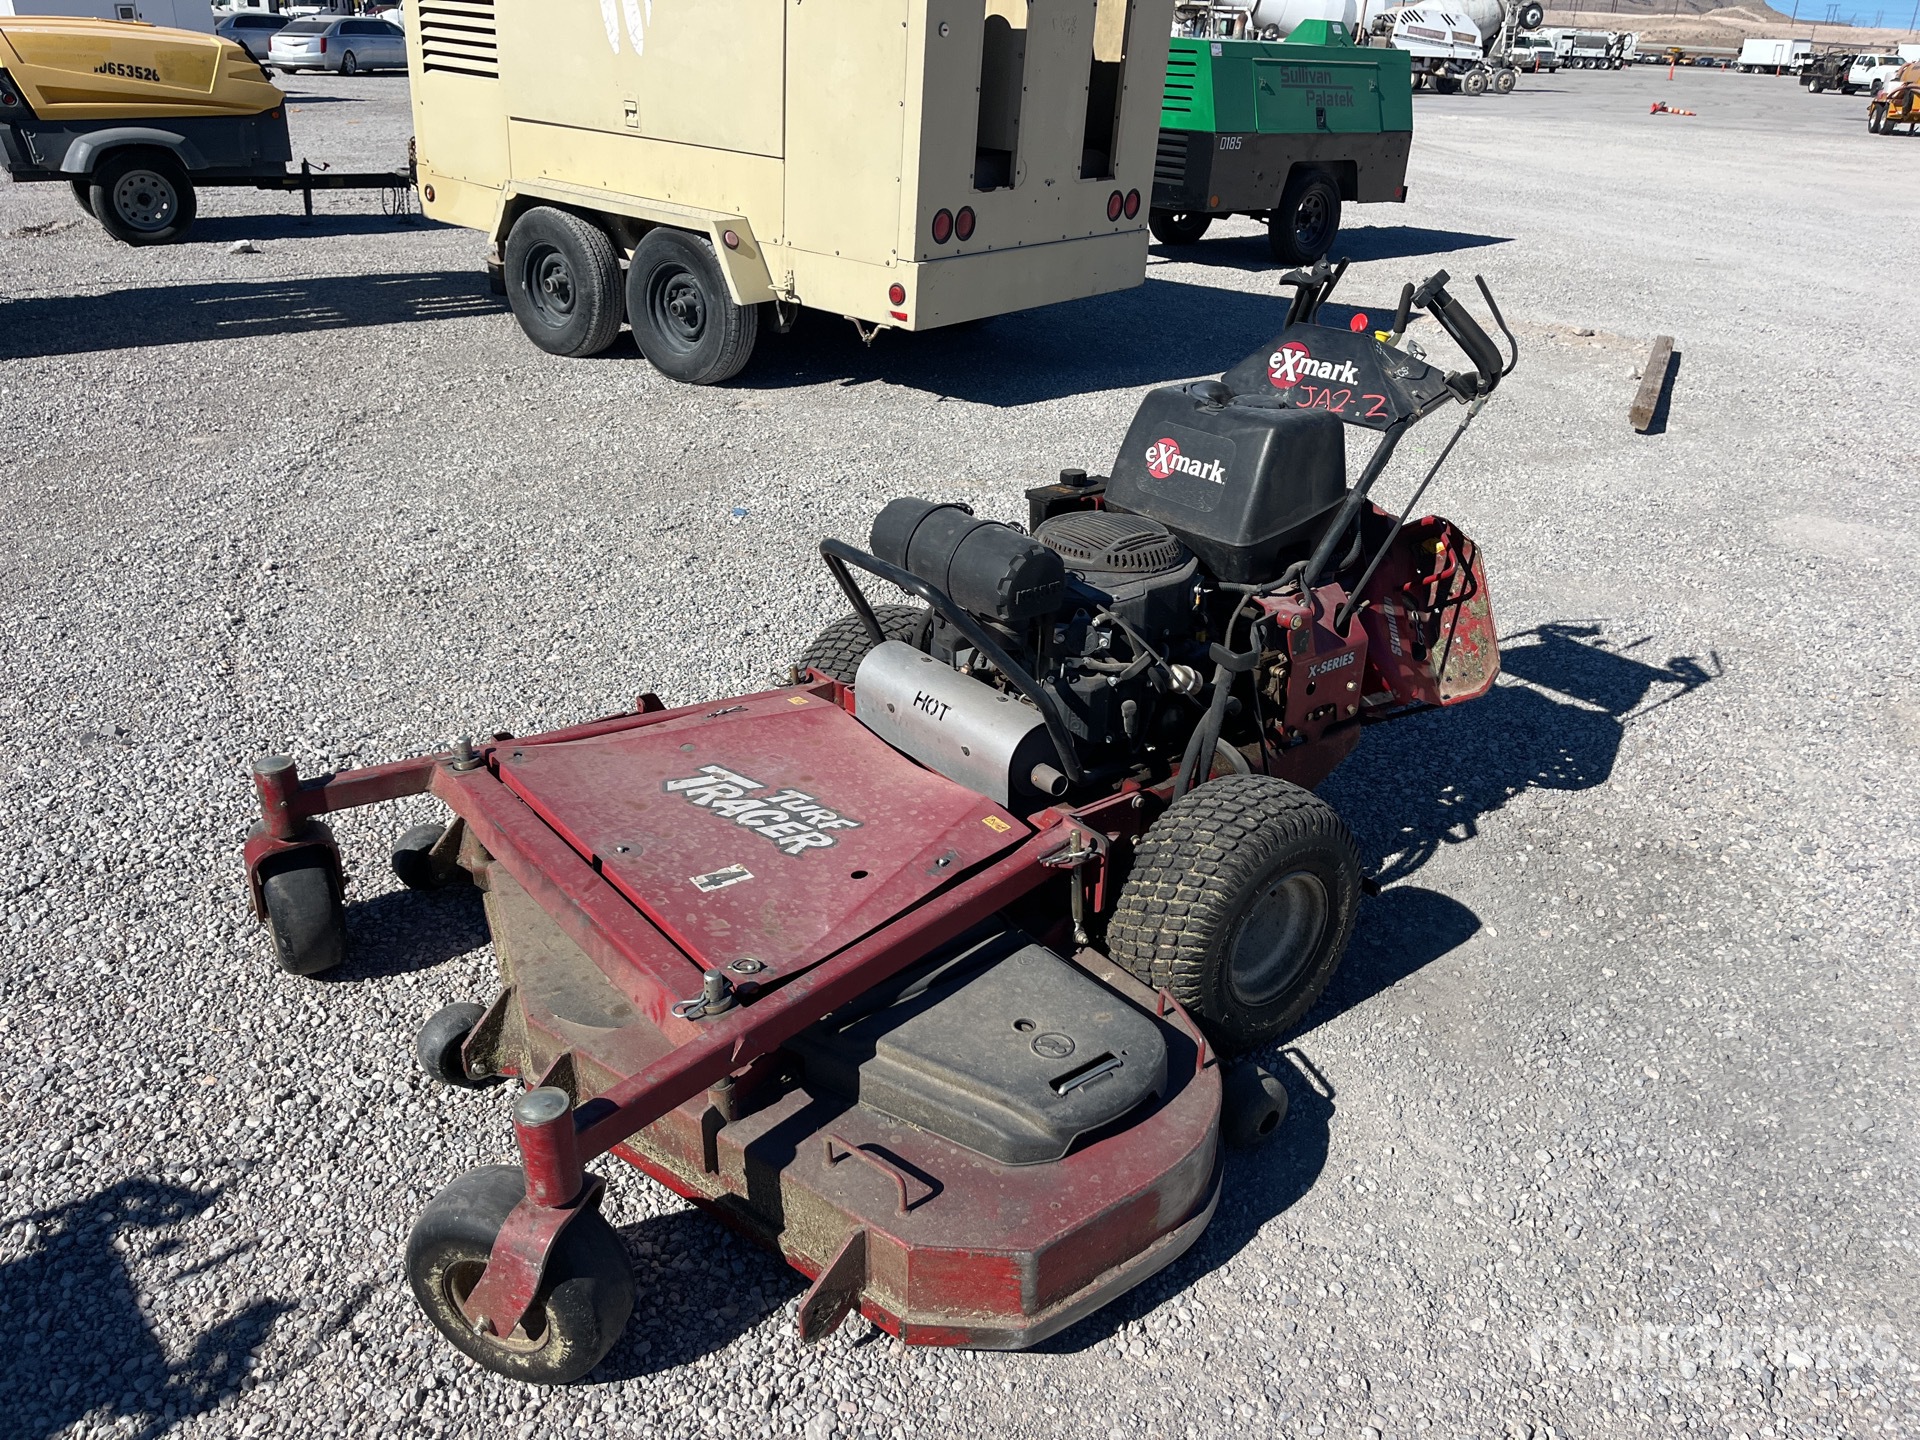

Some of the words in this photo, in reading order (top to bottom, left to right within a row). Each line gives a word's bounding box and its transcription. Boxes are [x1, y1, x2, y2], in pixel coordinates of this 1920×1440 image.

[1280, 66, 1332, 84] Sullivan
[1306, 89, 1354, 107] Palatek
[1308, 651, 1355, 678] X-SERIES
[913, 690, 952, 721] HOT
[667, 765, 834, 854] TRACER
[764, 789, 861, 829] TURF
